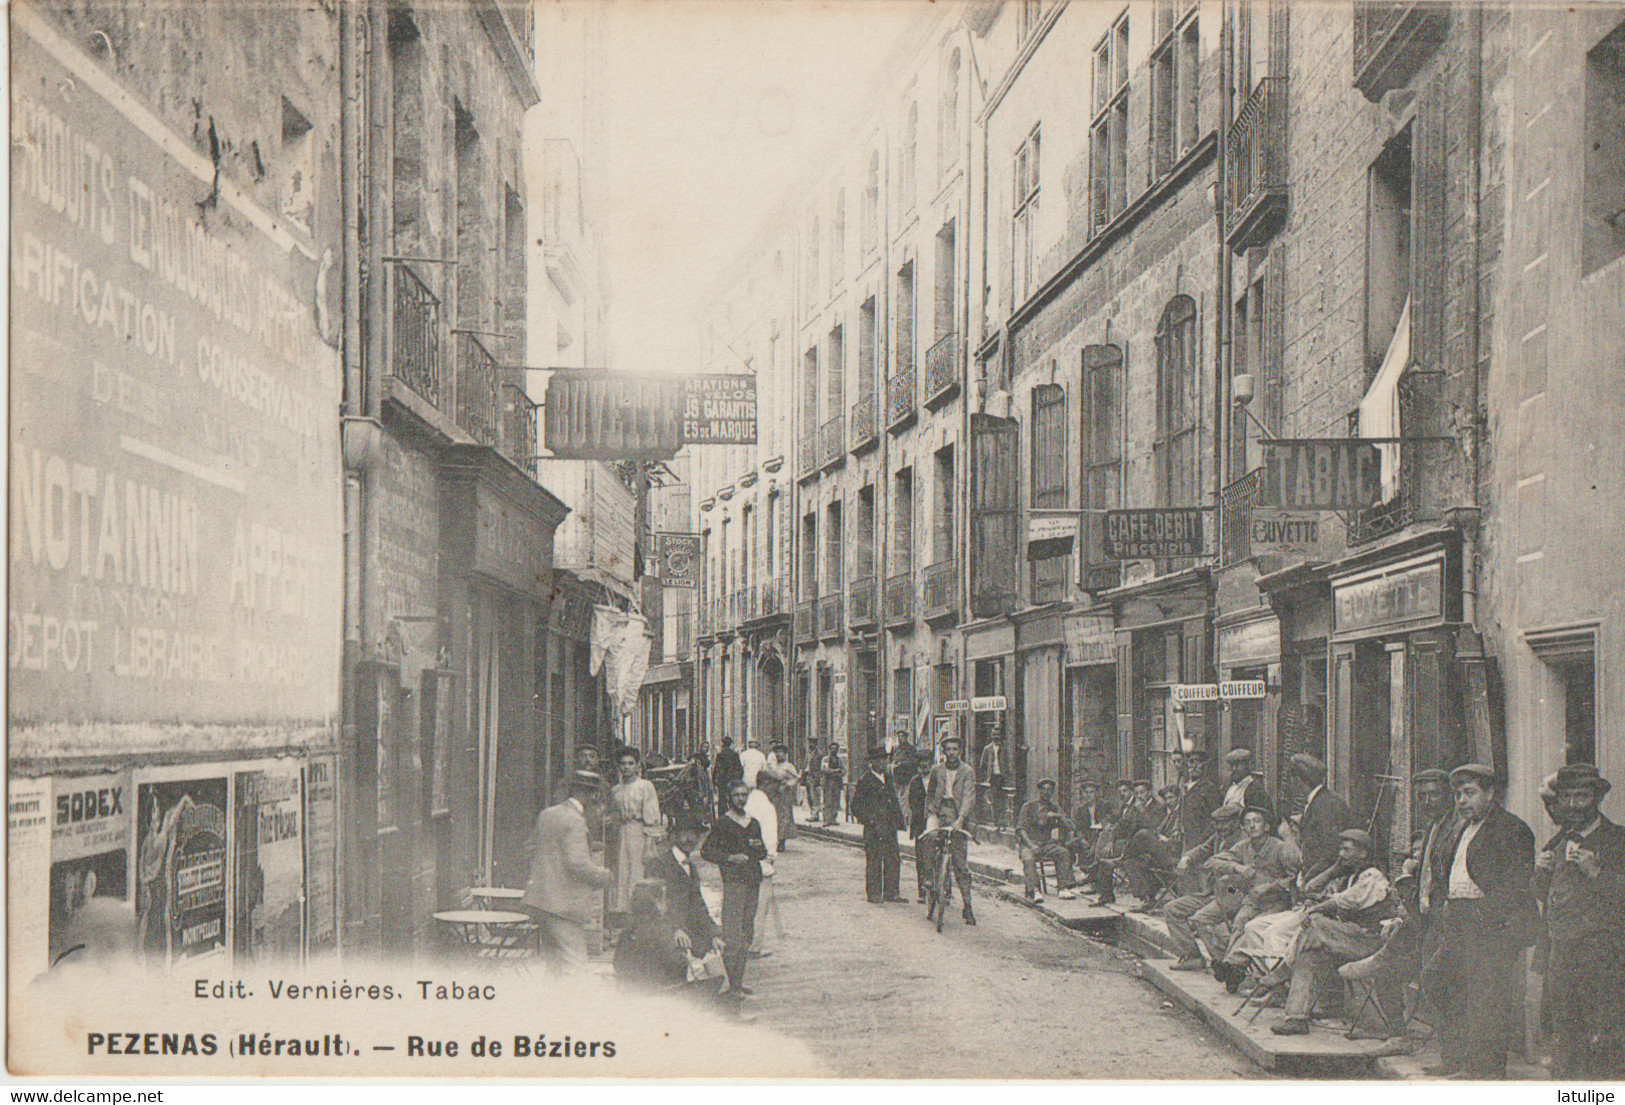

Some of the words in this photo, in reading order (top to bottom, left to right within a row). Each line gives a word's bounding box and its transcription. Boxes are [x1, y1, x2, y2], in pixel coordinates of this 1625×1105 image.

[704, 400, 756, 419] GARANTIS
[711, 421, 756, 440] MARQUE
[1275, 444, 1373, 506] TABAC
[1253, 520, 1318, 543] BUVETTE
[665, 537, 695, 547] STOCK
[1177, 687, 1218, 699] COIFFEUR
[1221, 682, 1266, 696] COIFFEUR
[56, 786, 123, 825] SODEX
